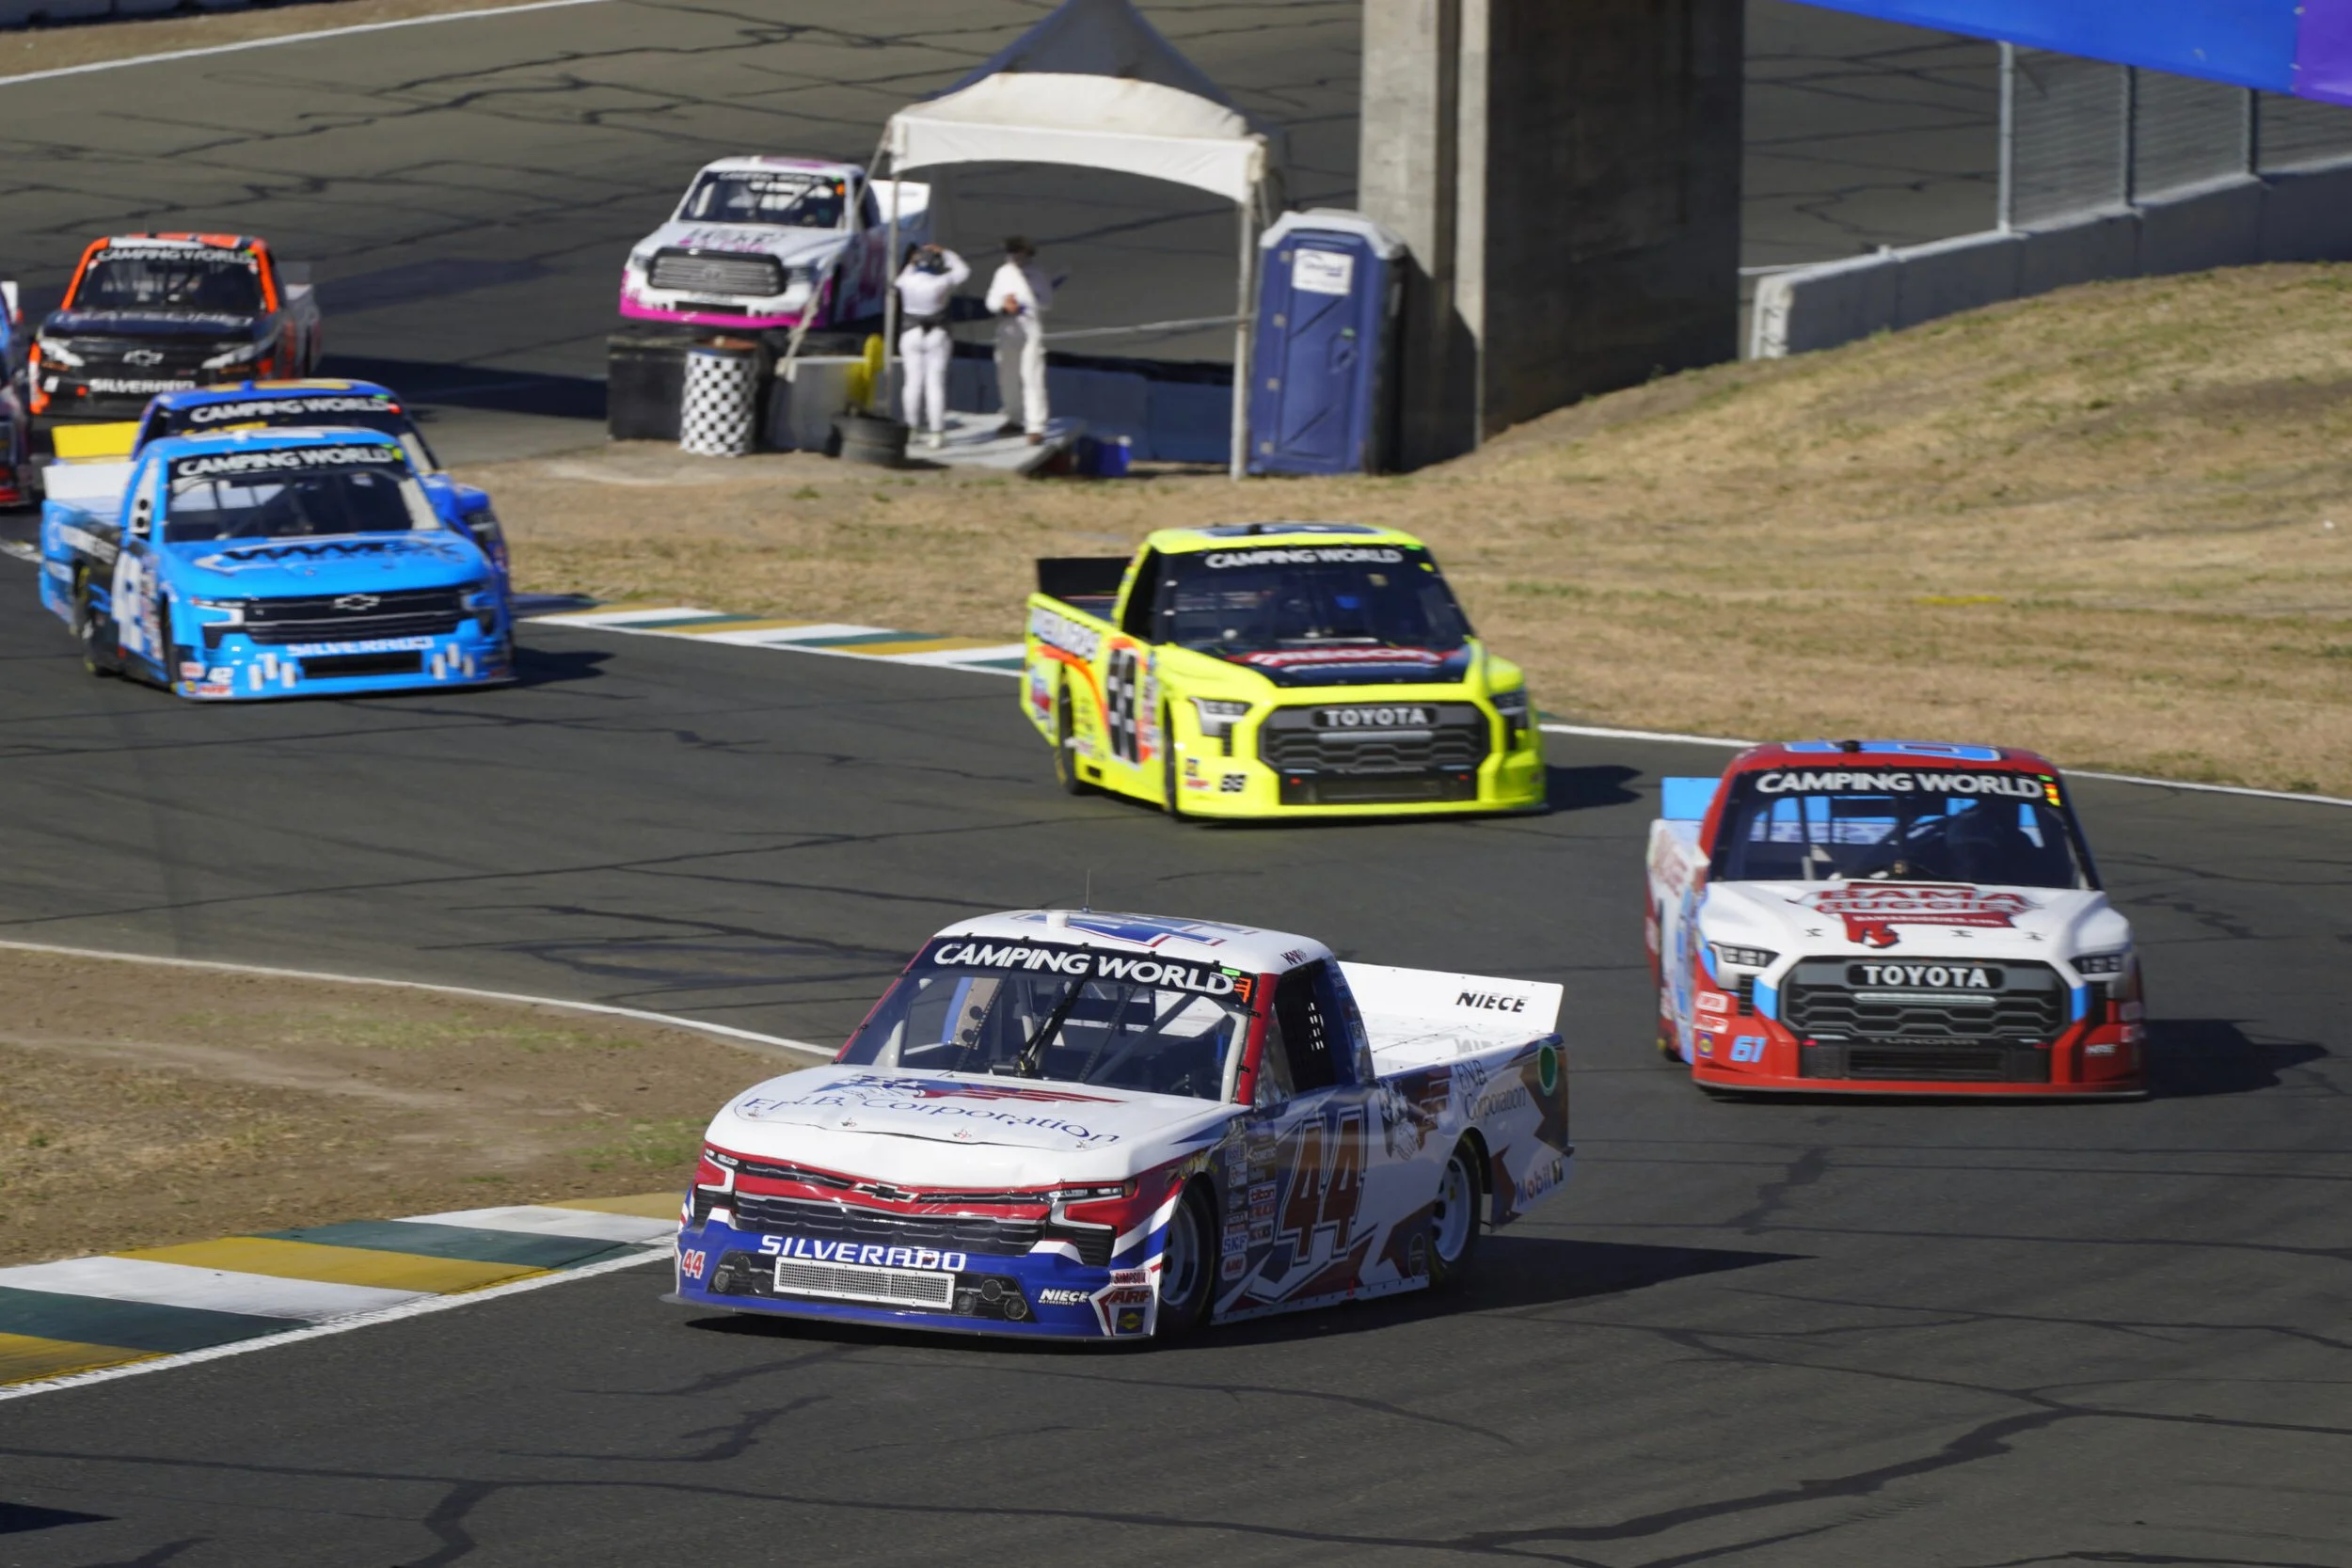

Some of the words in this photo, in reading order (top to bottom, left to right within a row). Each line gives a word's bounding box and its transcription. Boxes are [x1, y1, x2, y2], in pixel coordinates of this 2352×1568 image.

[190, 399, 303, 422] CAMPING
[304, 397, 389, 412] WORLD
[177, 451, 301, 476] CAMPING
[299, 447, 393, 464] WORLD
[1204, 549, 1317, 568] CAMPING
[1317, 548, 1403, 563] WORLD
[1324, 706, 1428, 727] TOYOTA
[1756, 771, 1915, 794] CAMPING
[1915, 772, 2045, 799] WORLD
[933, 943, 1092, 975] CAMPING
[1096, 956, 1237, 996] WORLD
[1862, 964, 1991, 989] TOYOTA
[1455, 991, 1528, 1013] NIECE
[1729, 1036, 1767, 1063] 61
[1465, 1085, 1527, 1125] Corporation
[863, 1097, 1120, 1144] Corporation
[1276, 1105, 1368, 1267] 44
[682, 1248, 706, 1279] 44
[757, 1234, 967, 1273] SILVERADO
[1113, 1271, 1146, 1285] SIMPSON
[1039, 1288, 1089, 1303] NIECE
